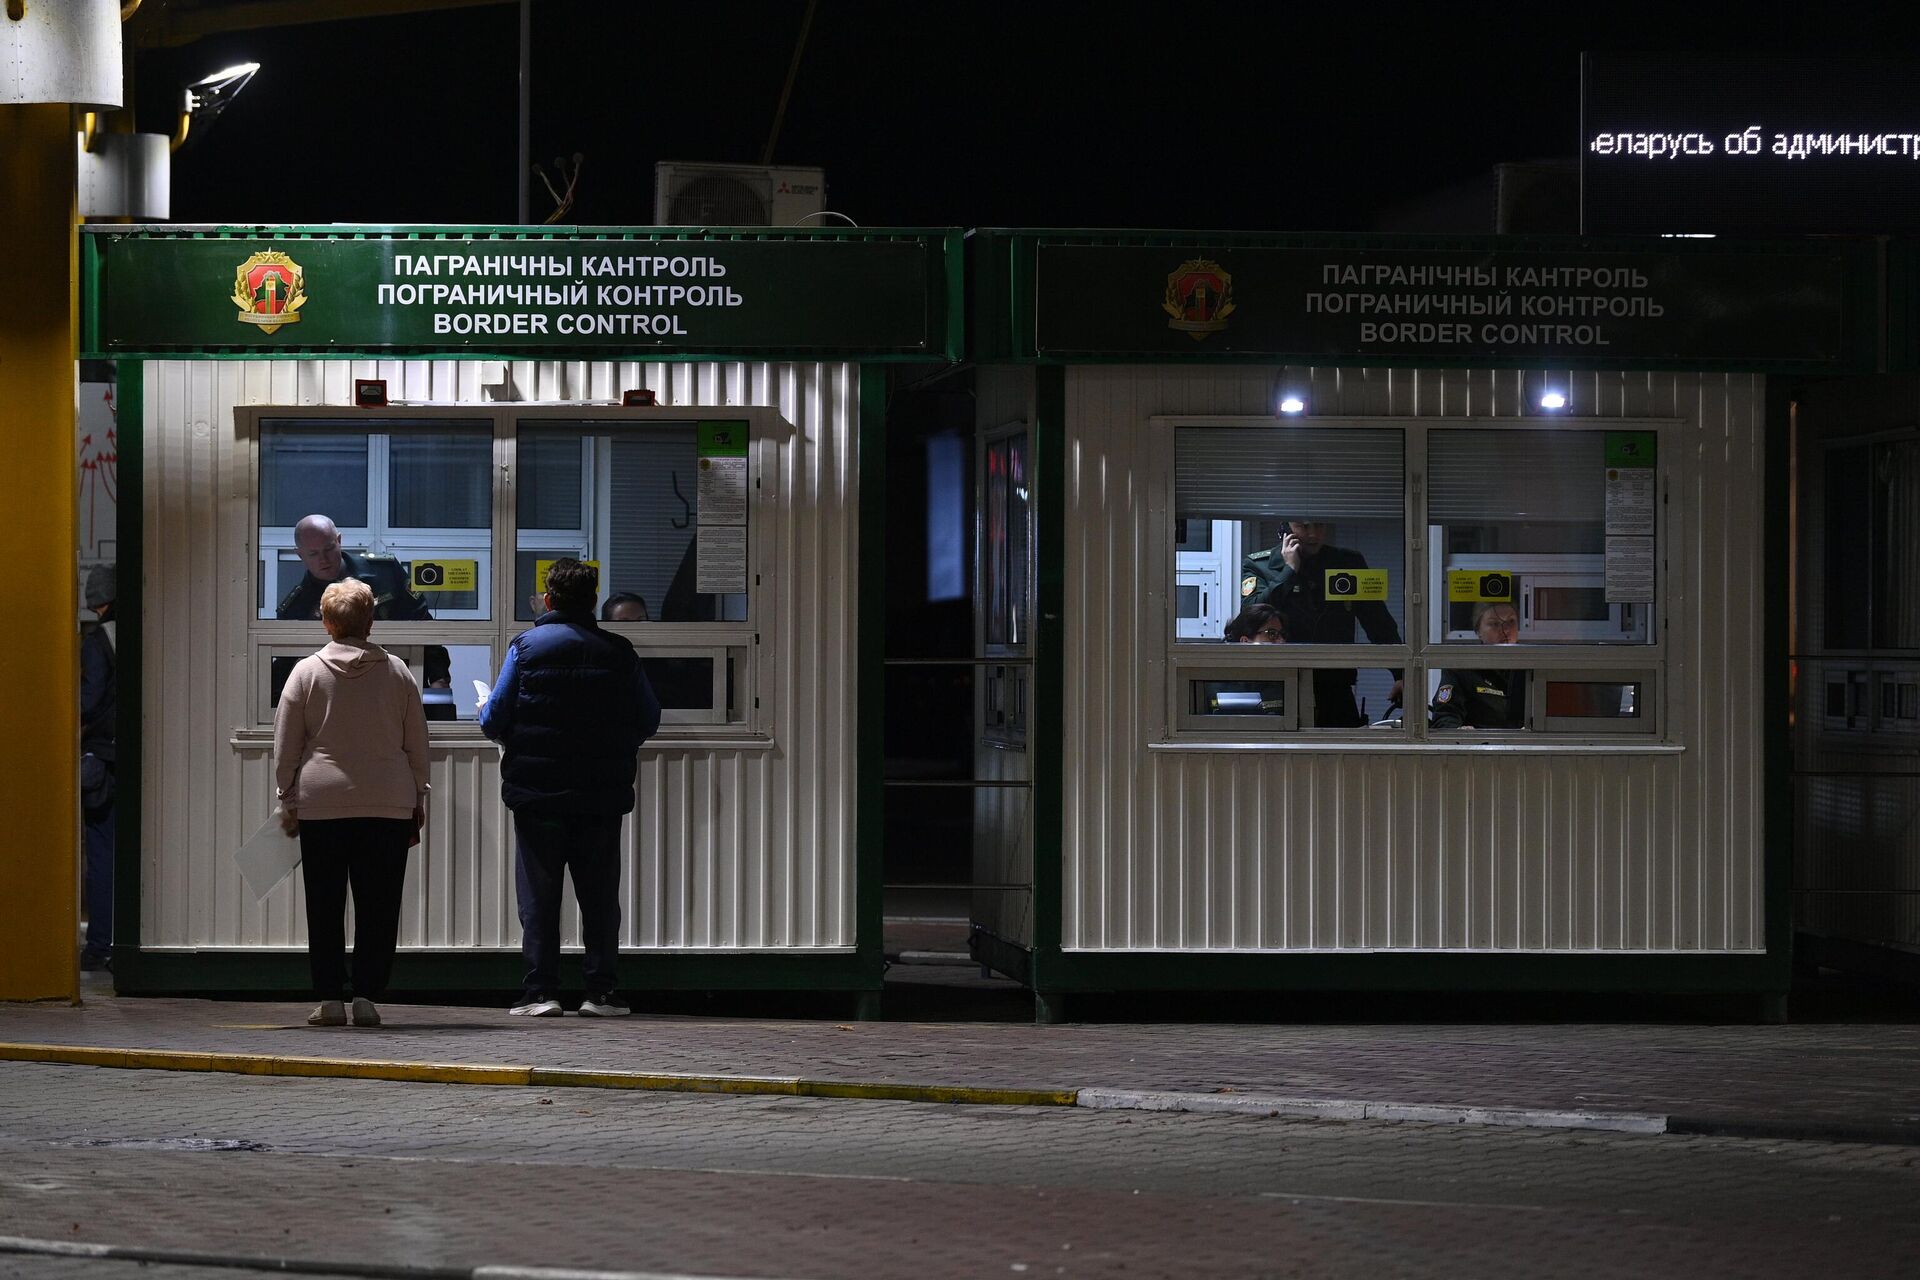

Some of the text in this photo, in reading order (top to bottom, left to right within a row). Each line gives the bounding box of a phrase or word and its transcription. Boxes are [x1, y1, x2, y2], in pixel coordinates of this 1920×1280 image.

[1591, 133, 1714, 160] еларусь
[1725, 125, 1762, 155] об
[393, 254, 727, 277] ПАГРАНІЧНЫ КАНТРОЛЬ
[1322, 264, 1649, 288] ПАГРАНІЧНЫ КАНТРОЛЬ
[377, 280, 743, 306] ПОГРАНИЧНЫЙ КОНТРОЛЬ
[1306, 291, 1665, 318] ПОГРАНИЧНЫЙ КОНТРОЛЬ
[434, 313, 688, 335] BORDER CONTROL
[1361, 322, 1610, 345] BORDER CONTROL
